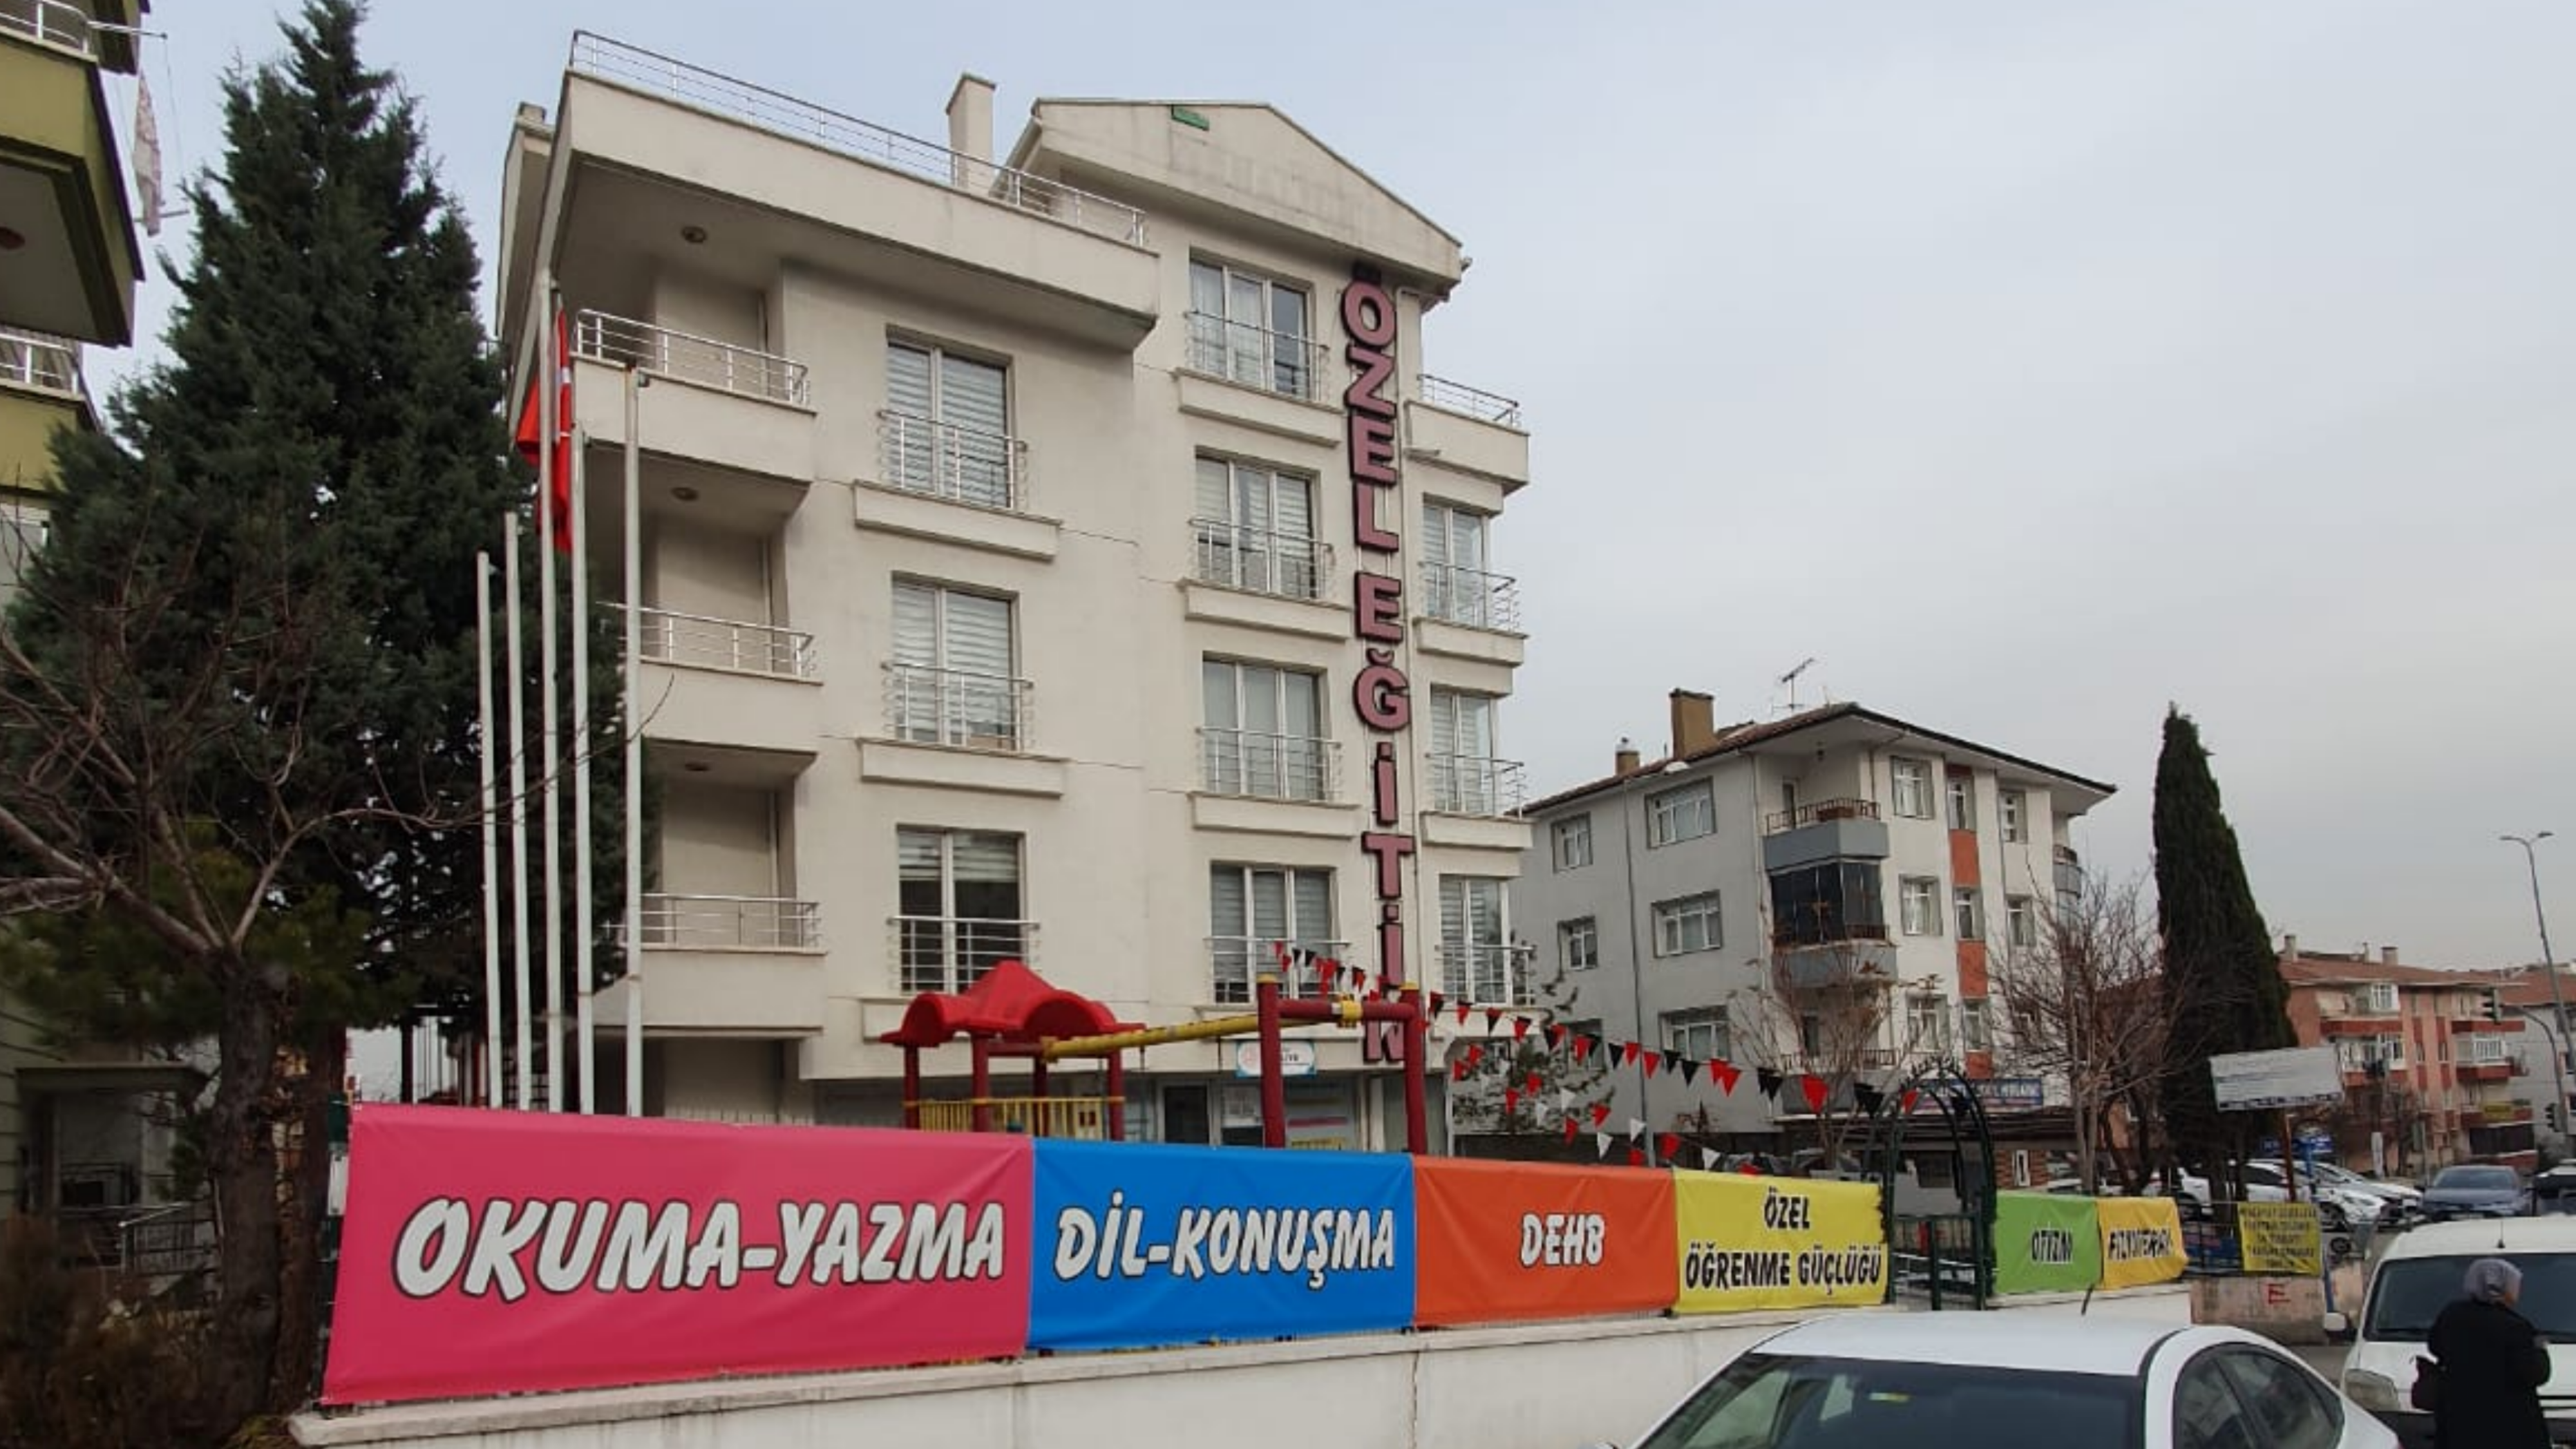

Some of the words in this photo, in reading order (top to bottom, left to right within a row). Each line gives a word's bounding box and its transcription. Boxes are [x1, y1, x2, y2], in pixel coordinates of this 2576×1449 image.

[1763, 1186, 1810, 1229] ÖZEL
[394, 1196, 1005, 1302] OKUMA-YAZMA
[1054, 1190, 1396, 1289] DİL-KONUŞMA
[1520, 1213, 1605, 1267] DEHB
[1685, 1241, 1790, 1291] ÖĞRENME
[1797, 1244, 1882, 1296] GÜÇLÜĞÜ
